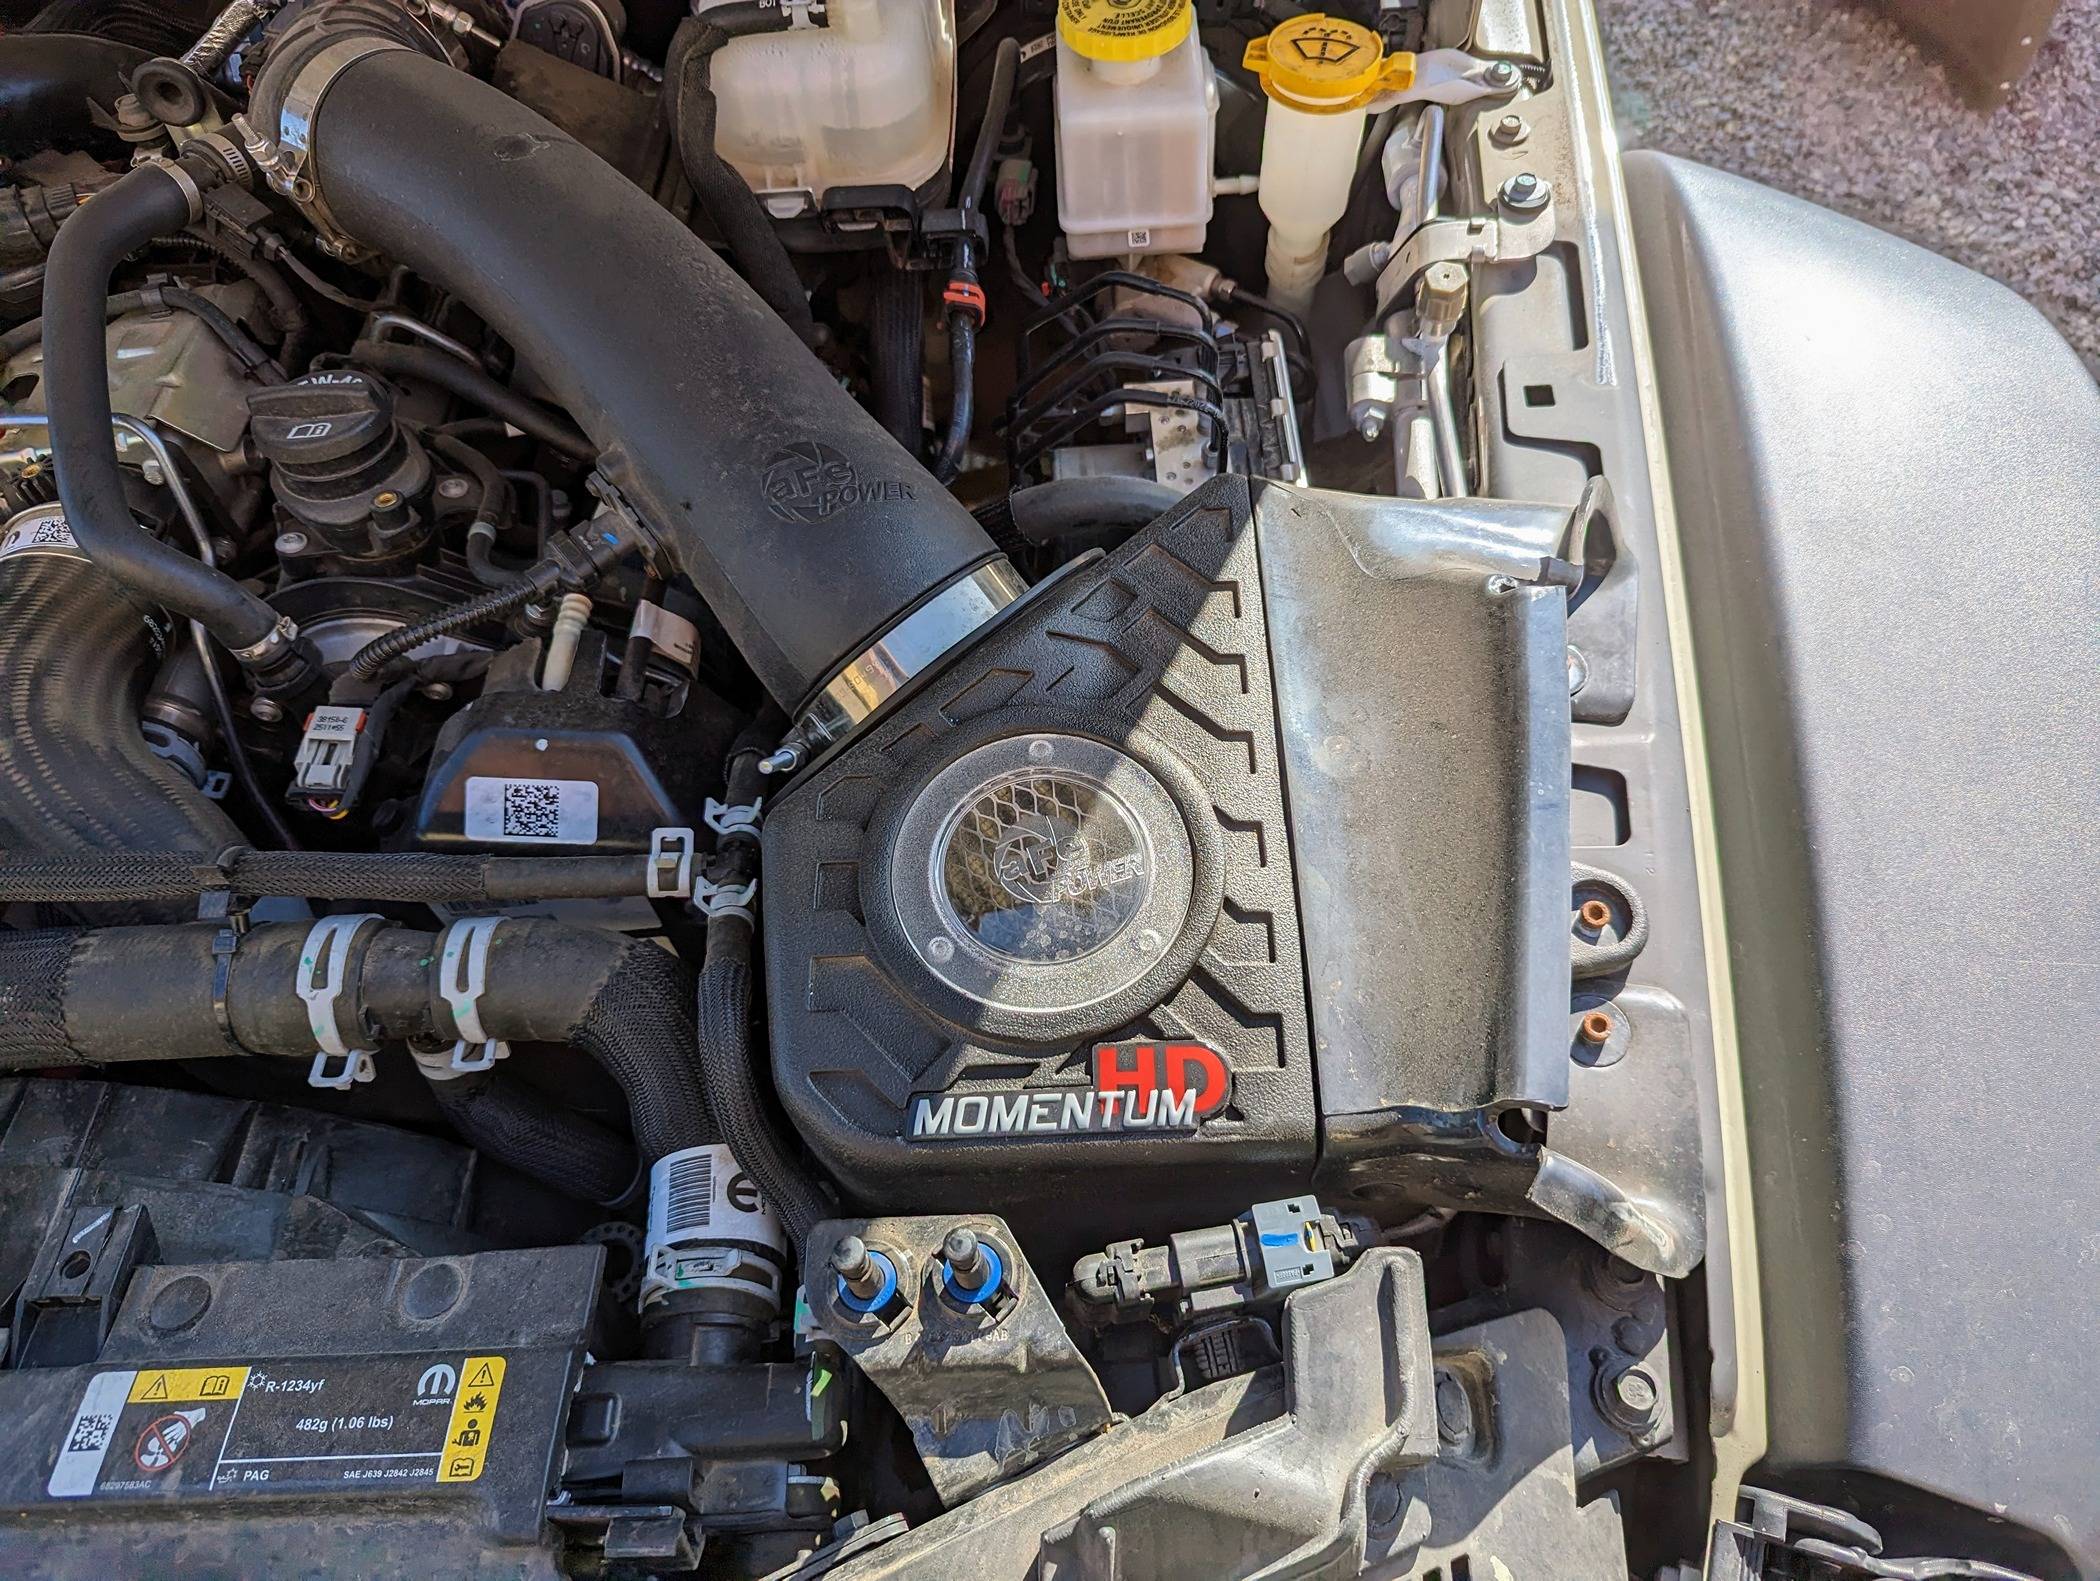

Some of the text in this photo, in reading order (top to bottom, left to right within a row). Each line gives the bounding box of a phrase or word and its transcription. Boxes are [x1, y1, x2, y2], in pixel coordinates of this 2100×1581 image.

[1096, 22, 1144, 31] UNIQUEMENT
[817, 481, 917, 515] POWER
[1052, 852, 1145, 903] POWER
[1099, 1046, 1225, 1114] HD
[913, 1088, 1197, 1136] MOMENTUM
[265, 1379, 325, 1393] R-1234yf
[412, 1398, 450, 1406] MOPAR
[295, 1415, 394, 1433] 482g (1.06 lbs)
[243, 1468, 434, 1481] PAG SAE J639 J2842 J2845
